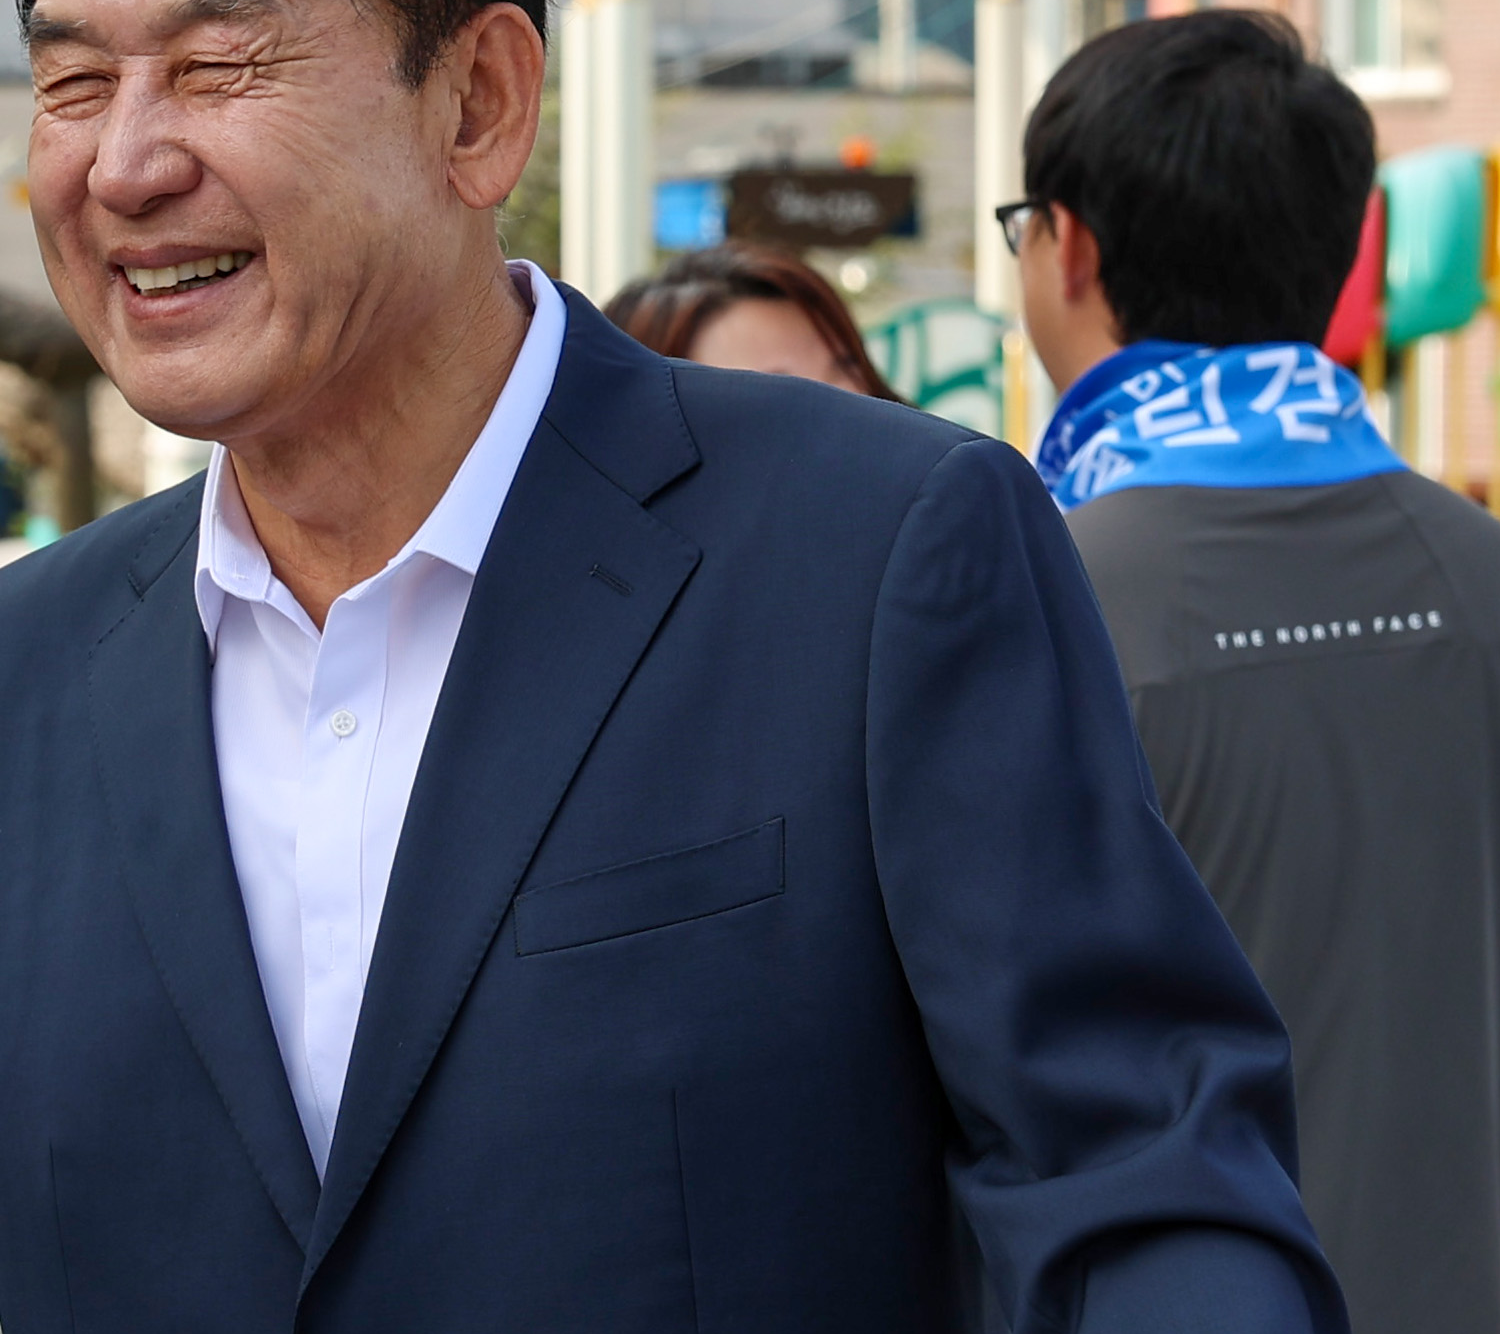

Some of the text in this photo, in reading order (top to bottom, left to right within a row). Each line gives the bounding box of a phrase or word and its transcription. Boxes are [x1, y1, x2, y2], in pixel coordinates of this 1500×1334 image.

[1214, 610, 1442, 651] THE NORTH FACE
